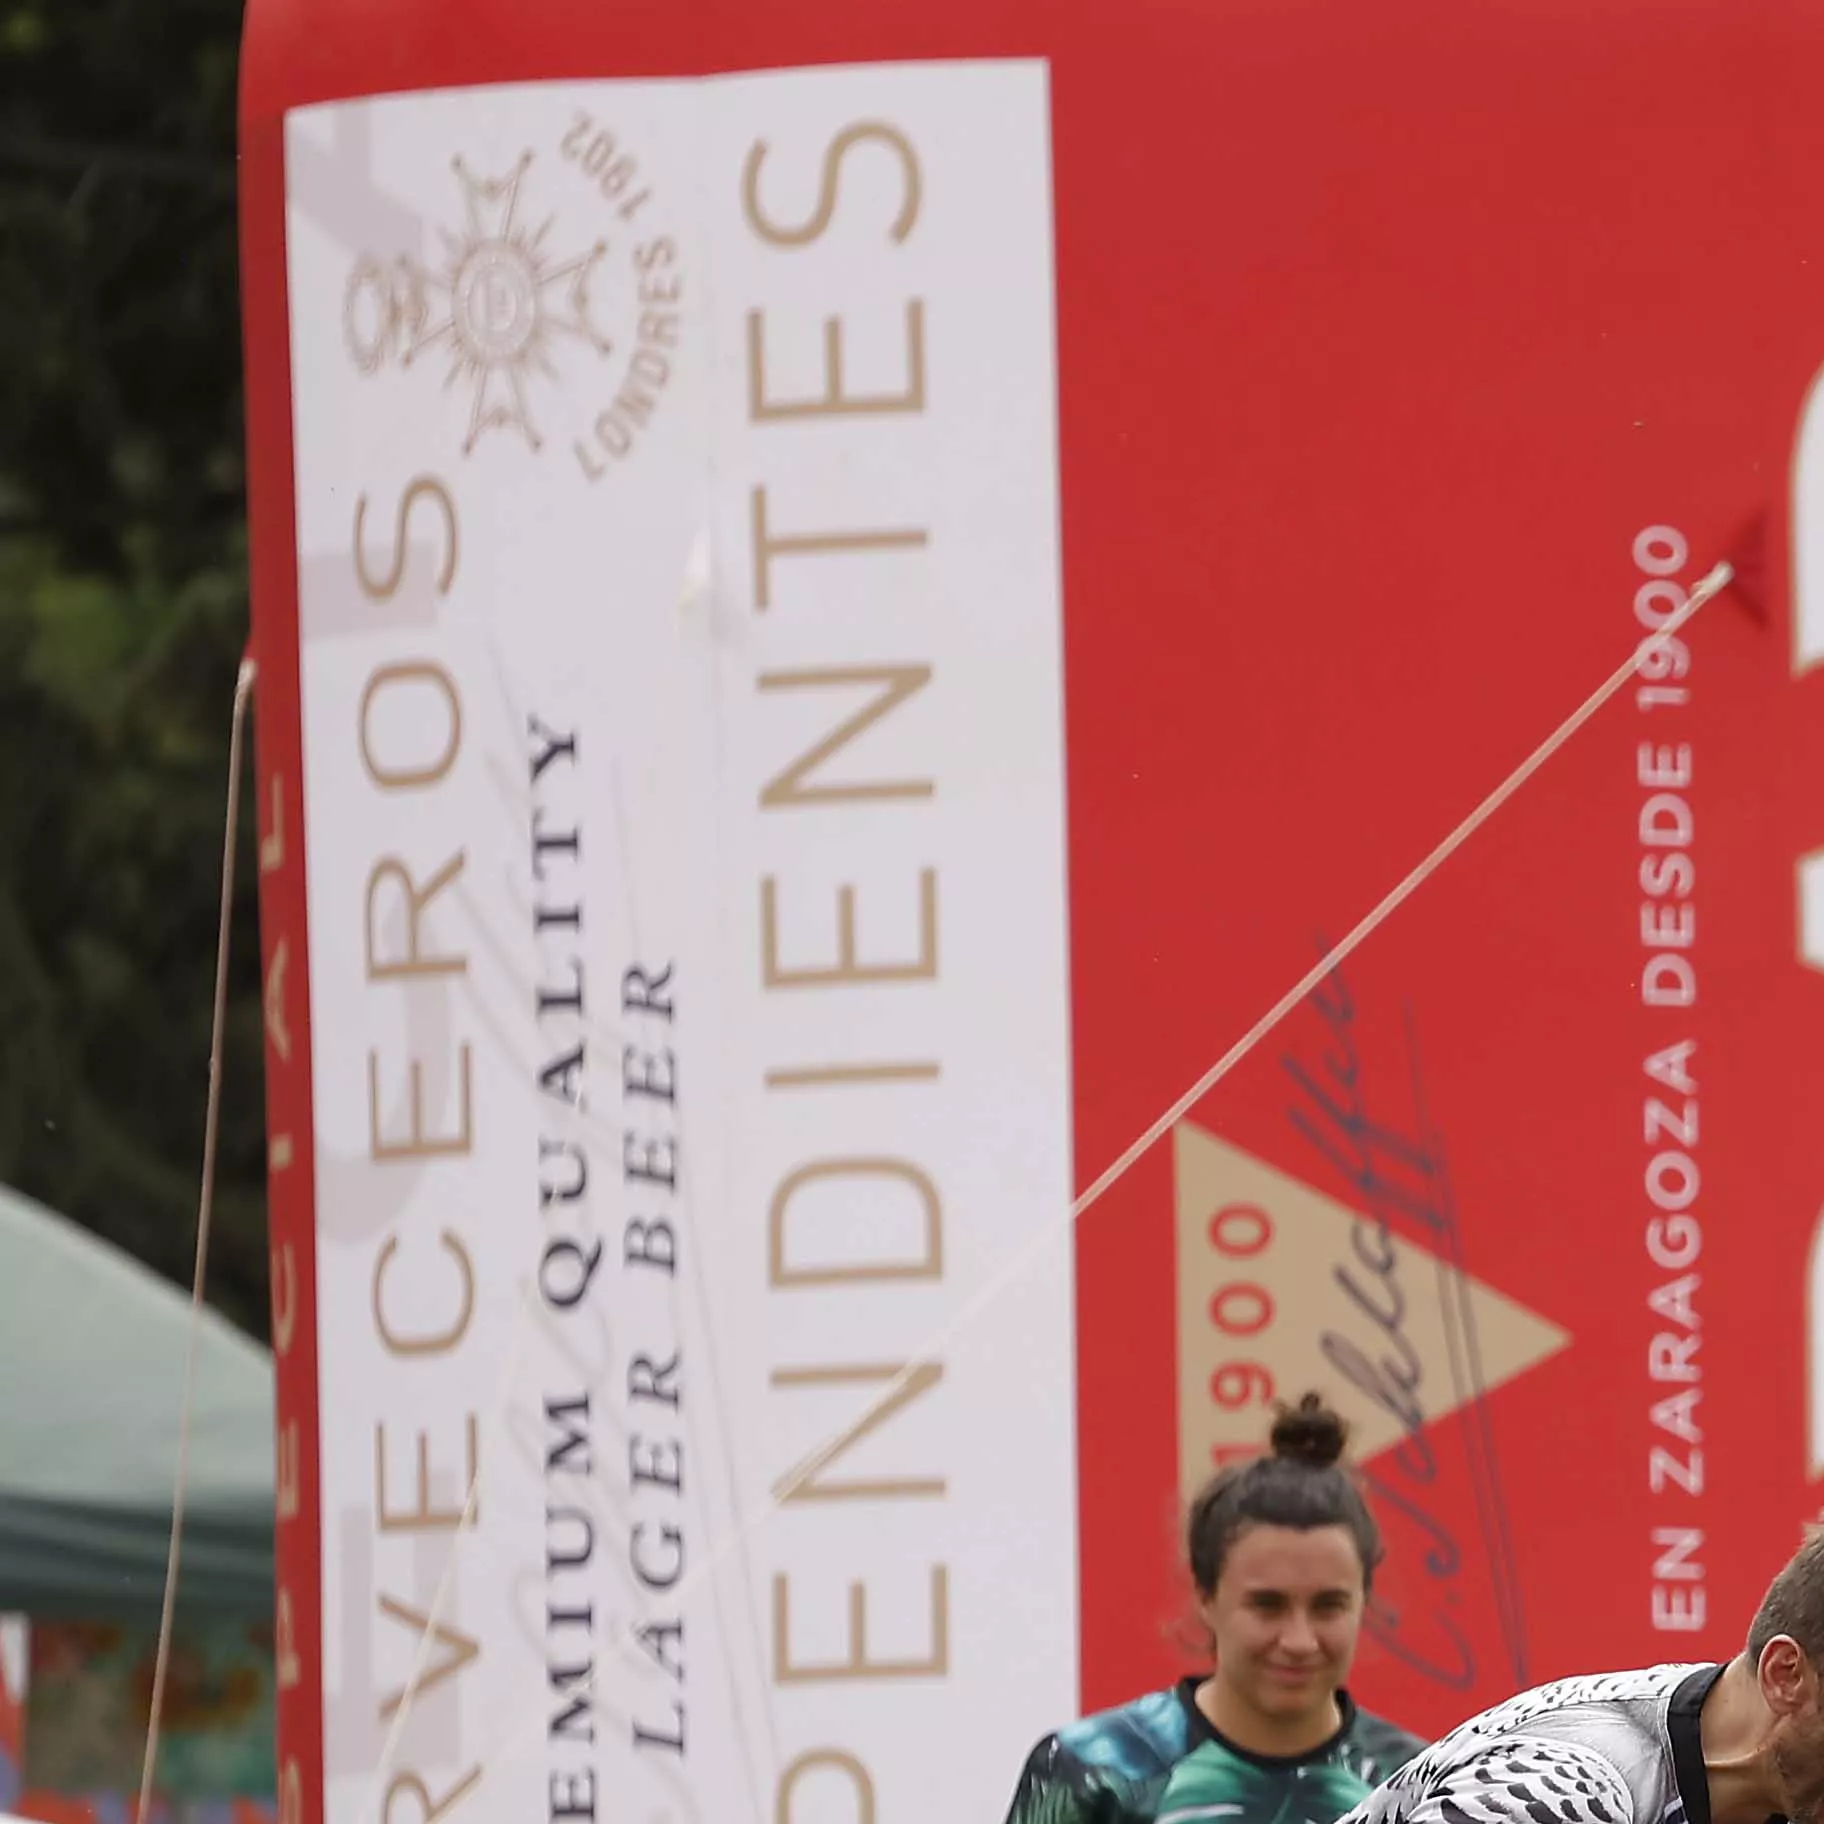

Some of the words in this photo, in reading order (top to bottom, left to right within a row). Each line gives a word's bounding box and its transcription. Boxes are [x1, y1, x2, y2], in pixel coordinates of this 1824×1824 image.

[560, 109, 650, 223] 1902
[572, 236, 684, 484] LONDRES
[1632, 526, 1691, 710] 1900
[1637, 741, 1698, 1007] DESDE
[527, 713, 603, 1309] QUALITY
[621, 959, 678, 1277] BEER
[1207, 1202, 1276, 1467] 1900
[1644, 1038, 1706, 1495] ZARAGOZA
[627, 1348, 687, 1756] LAGER
[1651, 1530, 1706, 1632] EN
